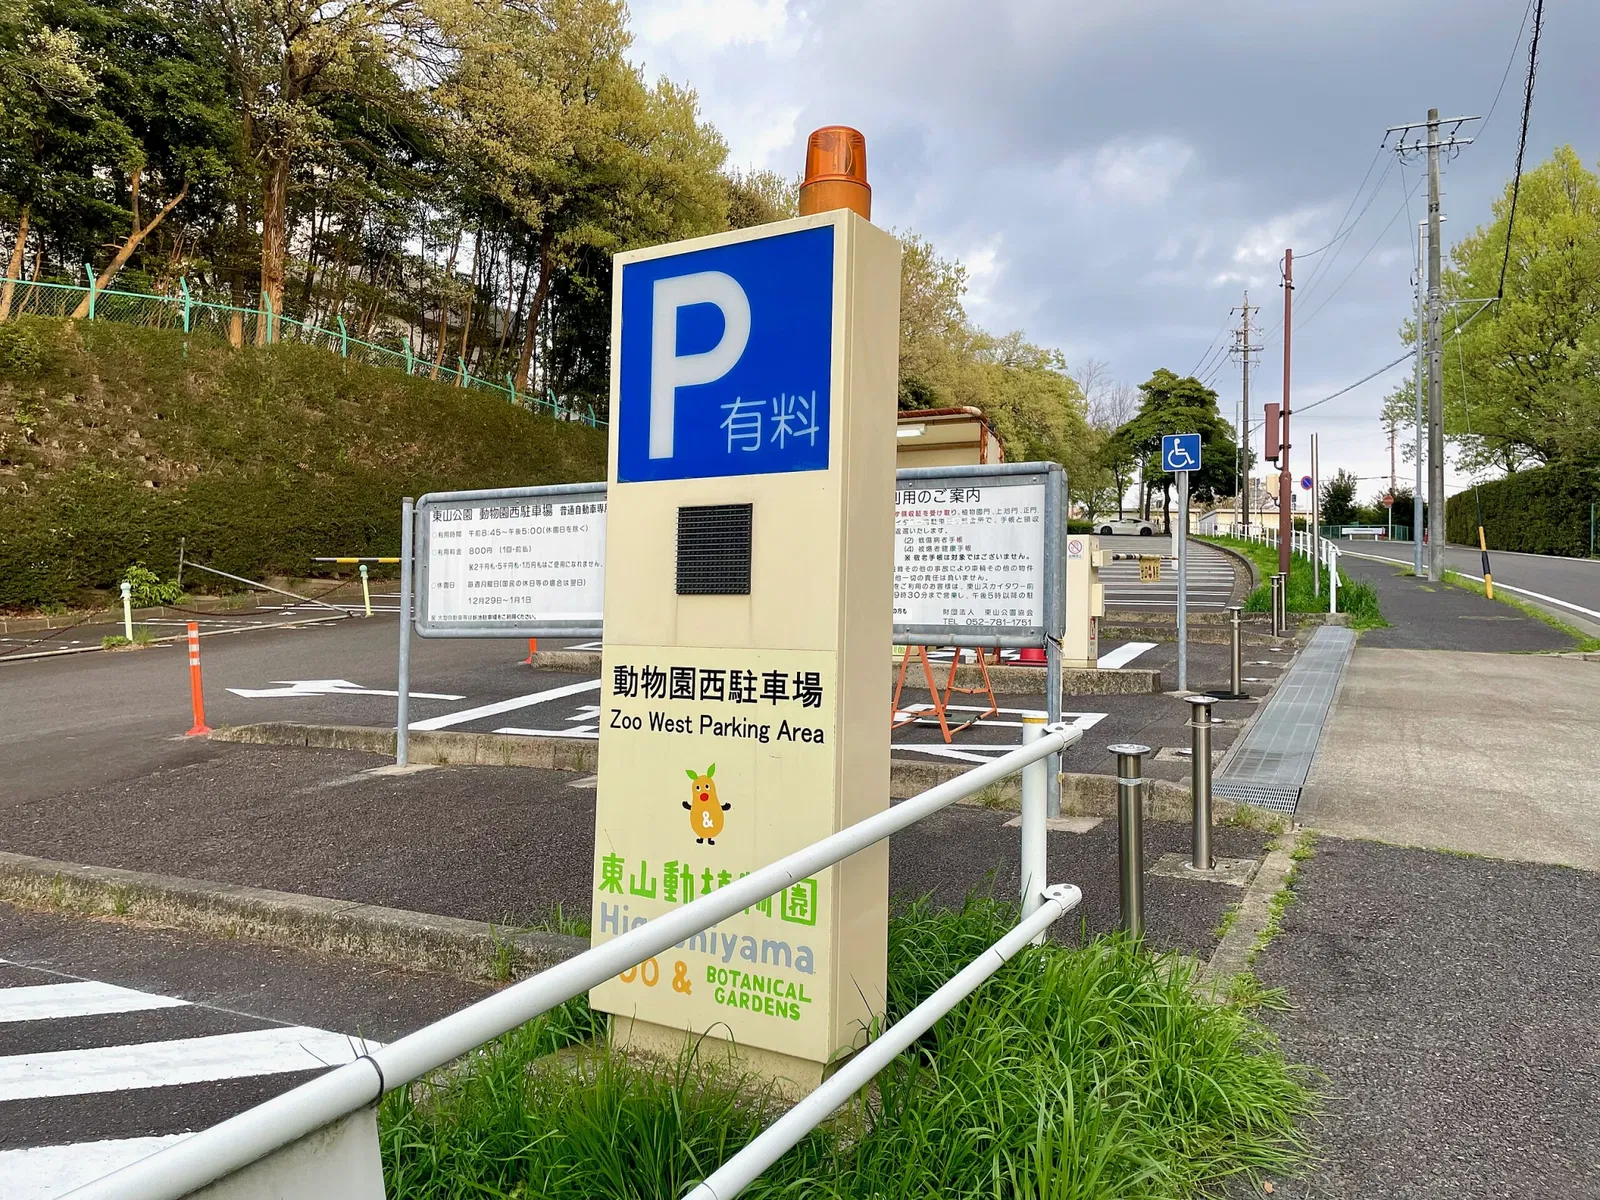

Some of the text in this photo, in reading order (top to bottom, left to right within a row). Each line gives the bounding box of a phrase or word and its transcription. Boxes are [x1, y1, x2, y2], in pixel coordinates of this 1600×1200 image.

[649, 270, 752, 460] P
[720, 390, 820, 454] 有料
[432, 508, 473, 522] 東山公園
[479, 504, 553, 520] 動物園西駐車場
[469, 547, 493, 555] 800円
[943, 618, 1032, 627] TEL 052-781-1751
[613, 665, 823, 708] 動物園西駐車場
[610, 709, 825, 744] Zoo West Parking Area
[672, 960, 692, 996] &
[706, 965, 812, 1004] BOTANICAL
[714, 986, 801, 1021] GARDENS
